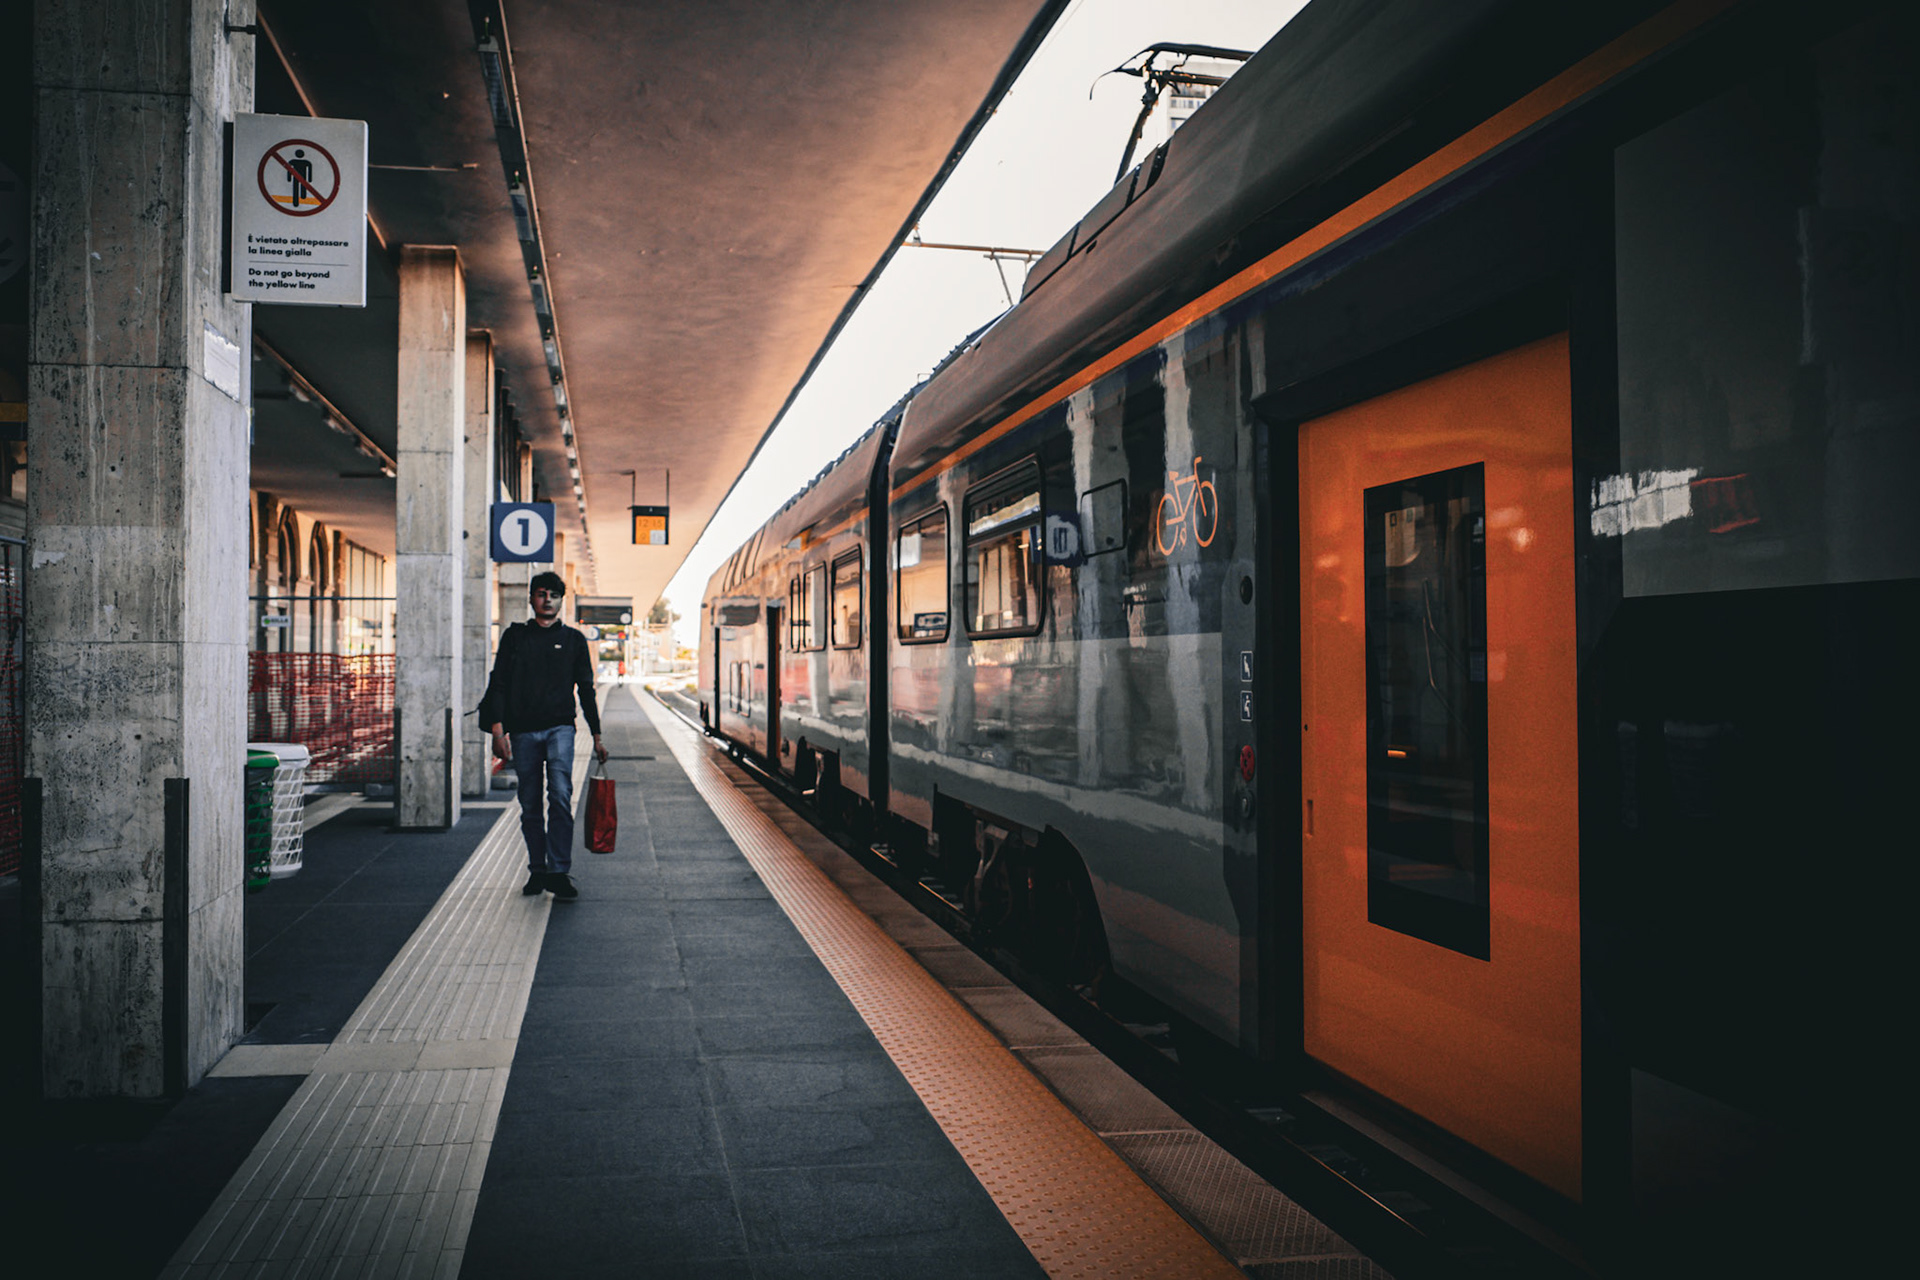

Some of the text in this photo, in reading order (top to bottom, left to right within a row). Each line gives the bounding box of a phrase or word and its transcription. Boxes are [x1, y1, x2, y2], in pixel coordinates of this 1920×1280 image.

[256, 236, 288, 244] vietato
[291, 237, 349, 247] oltrepassare
[249, 246, 312, 257] la linea gialla
[249, 268, 261, 276] Do
[281, 271, 293, 279] go
[296, 270, 330, 279] beyond
[249, 279, 315, 289] the yellow line
[639, 518, 649, 528] 12
[517, 518, 530, 546] 1
